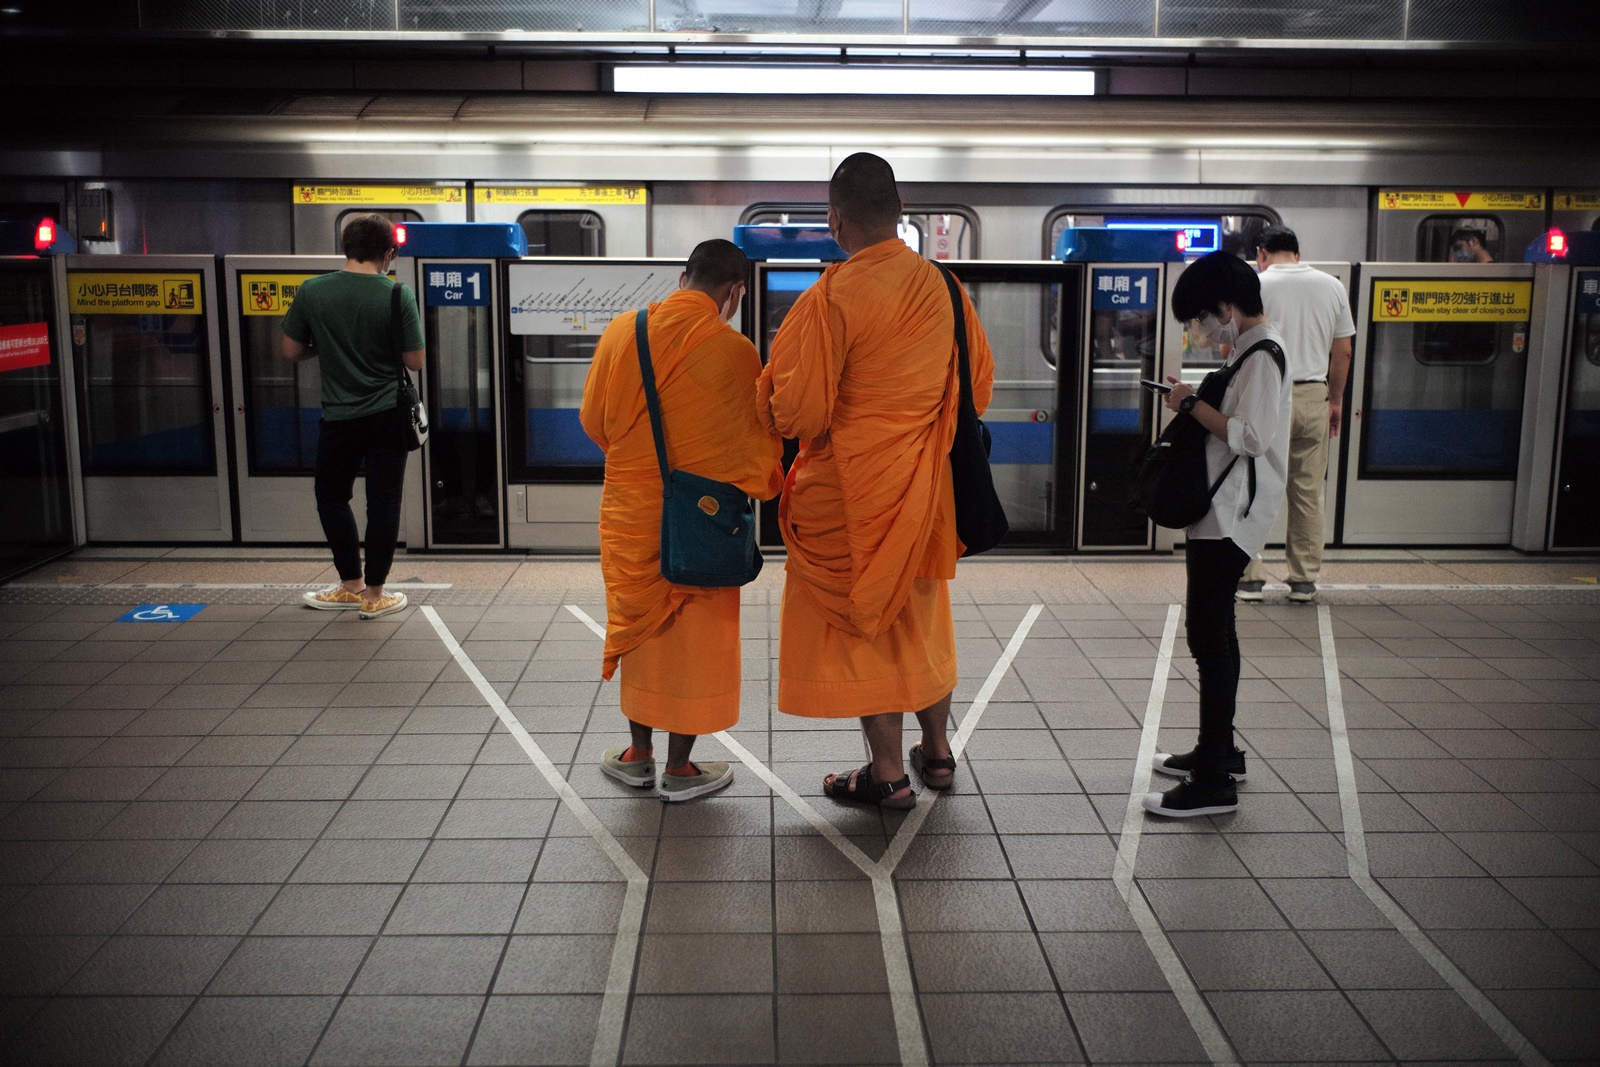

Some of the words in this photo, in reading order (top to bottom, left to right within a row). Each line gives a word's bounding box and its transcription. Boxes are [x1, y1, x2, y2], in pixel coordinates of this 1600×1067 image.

[80, 194, 101, 207] 211
[78, 283, 159, 297] 小心月台間隙
[430, 271, 462, 288] 車廂
[466, 272, 481, 300] 1
[1098, 275, 1130, 292] 車廂
[1134, 276, 1148, 304] 1
[444, 290, 464, 300] Car
[1111, 294, 1130, 304] Car
[1412, 291, 1515, 305] 關門時勿強行進出
[112, 299, 144, 308] platform
[146, 300, 160, 308] gap
[1436, 307, 1451, 315] stay
[1479, 307, 1505, 315] closing
